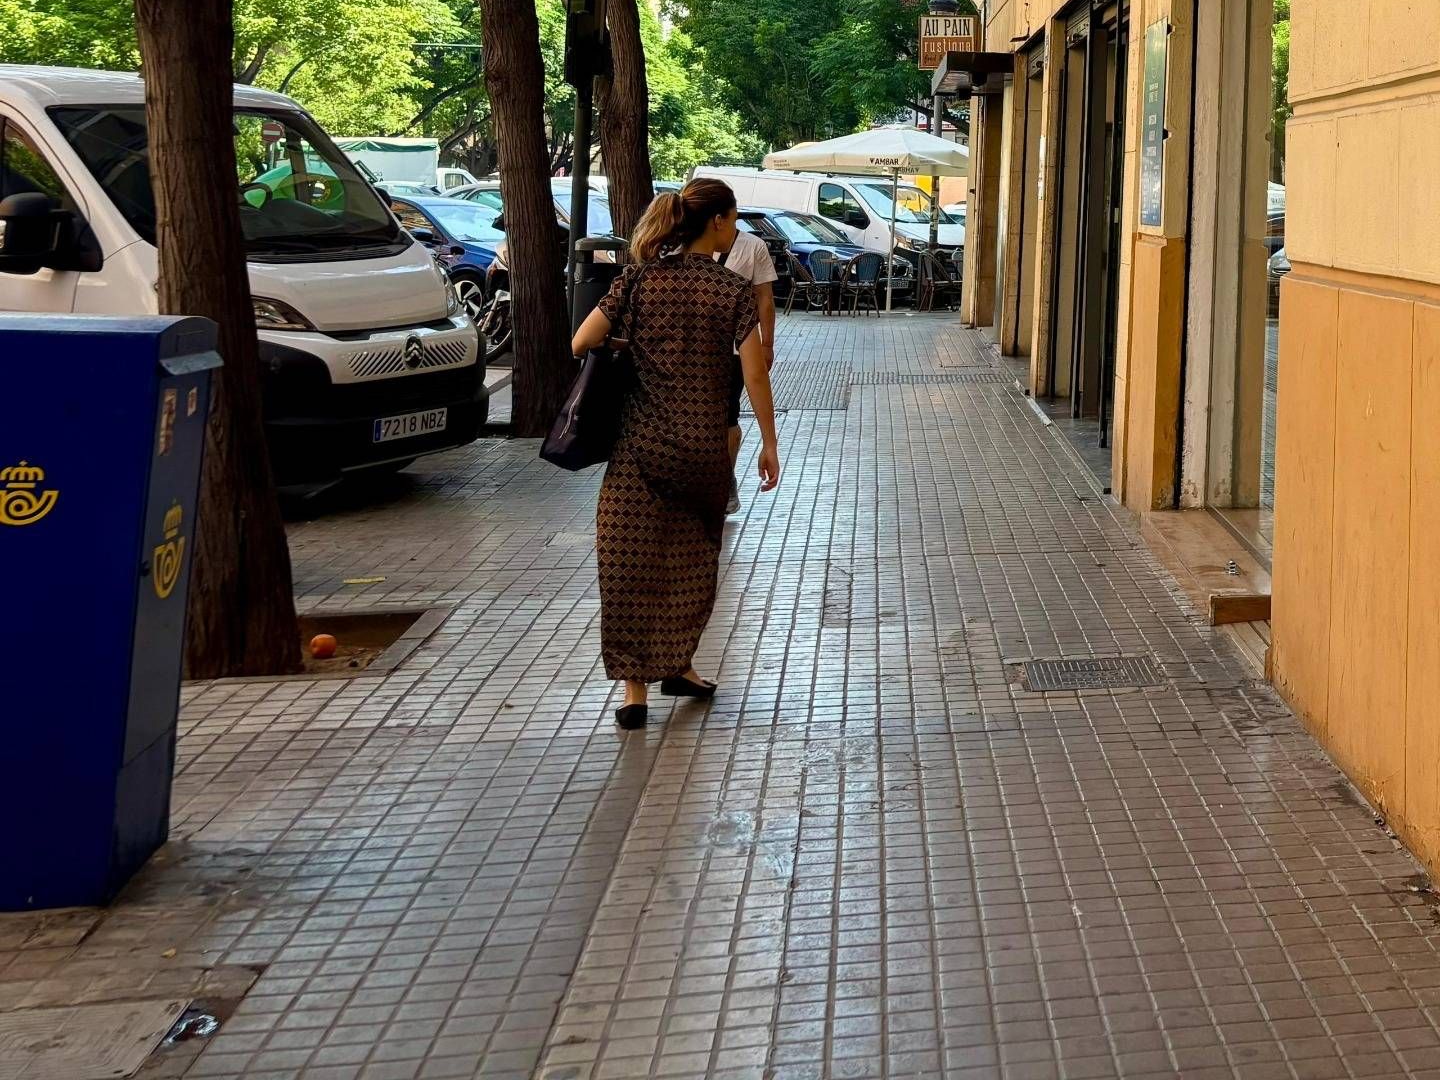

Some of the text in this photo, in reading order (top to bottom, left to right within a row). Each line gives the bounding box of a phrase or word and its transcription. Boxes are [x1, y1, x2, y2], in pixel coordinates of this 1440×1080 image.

[924, 18, 971, 36] AU PAIN
[875, 157, 899, 166] AMBAR
[384, 410, 445, 437] 7218 NBZ
